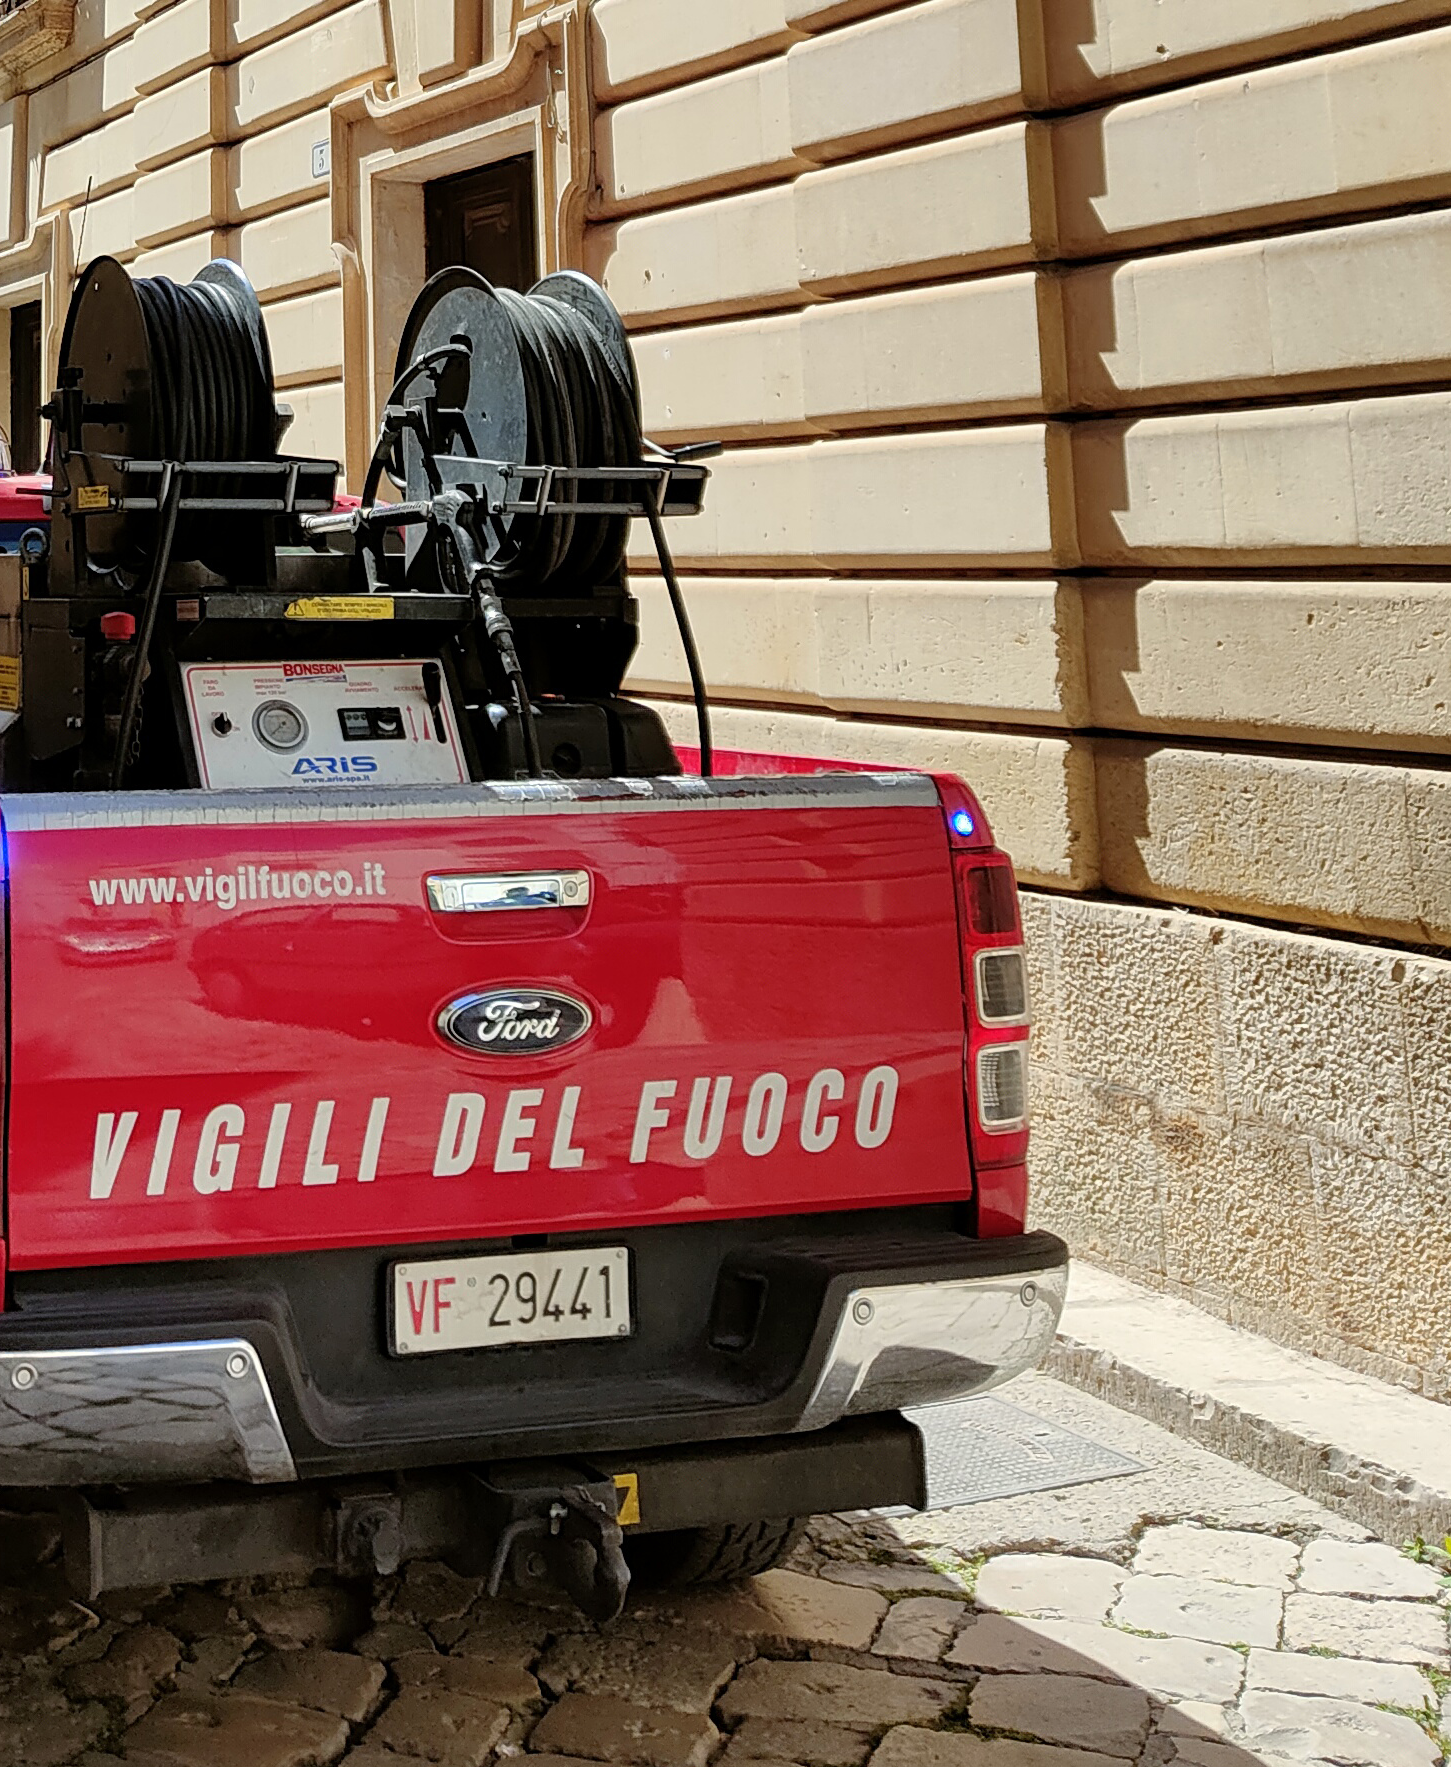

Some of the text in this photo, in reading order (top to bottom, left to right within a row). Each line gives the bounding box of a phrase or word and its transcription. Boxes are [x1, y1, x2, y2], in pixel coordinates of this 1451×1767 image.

[282, 663, 346, 677] BONSEGNA
[302, 774, 370, 783] www.aris-spa.it
[89, 862, 387, 910] www.vigilfuoco.it
[477, 1000, 562, 1042] Ford
[90, 1065, 899, 1199] VIGILI DEL FUOCO
[406, 1265, 612, 1336] VF 29441
